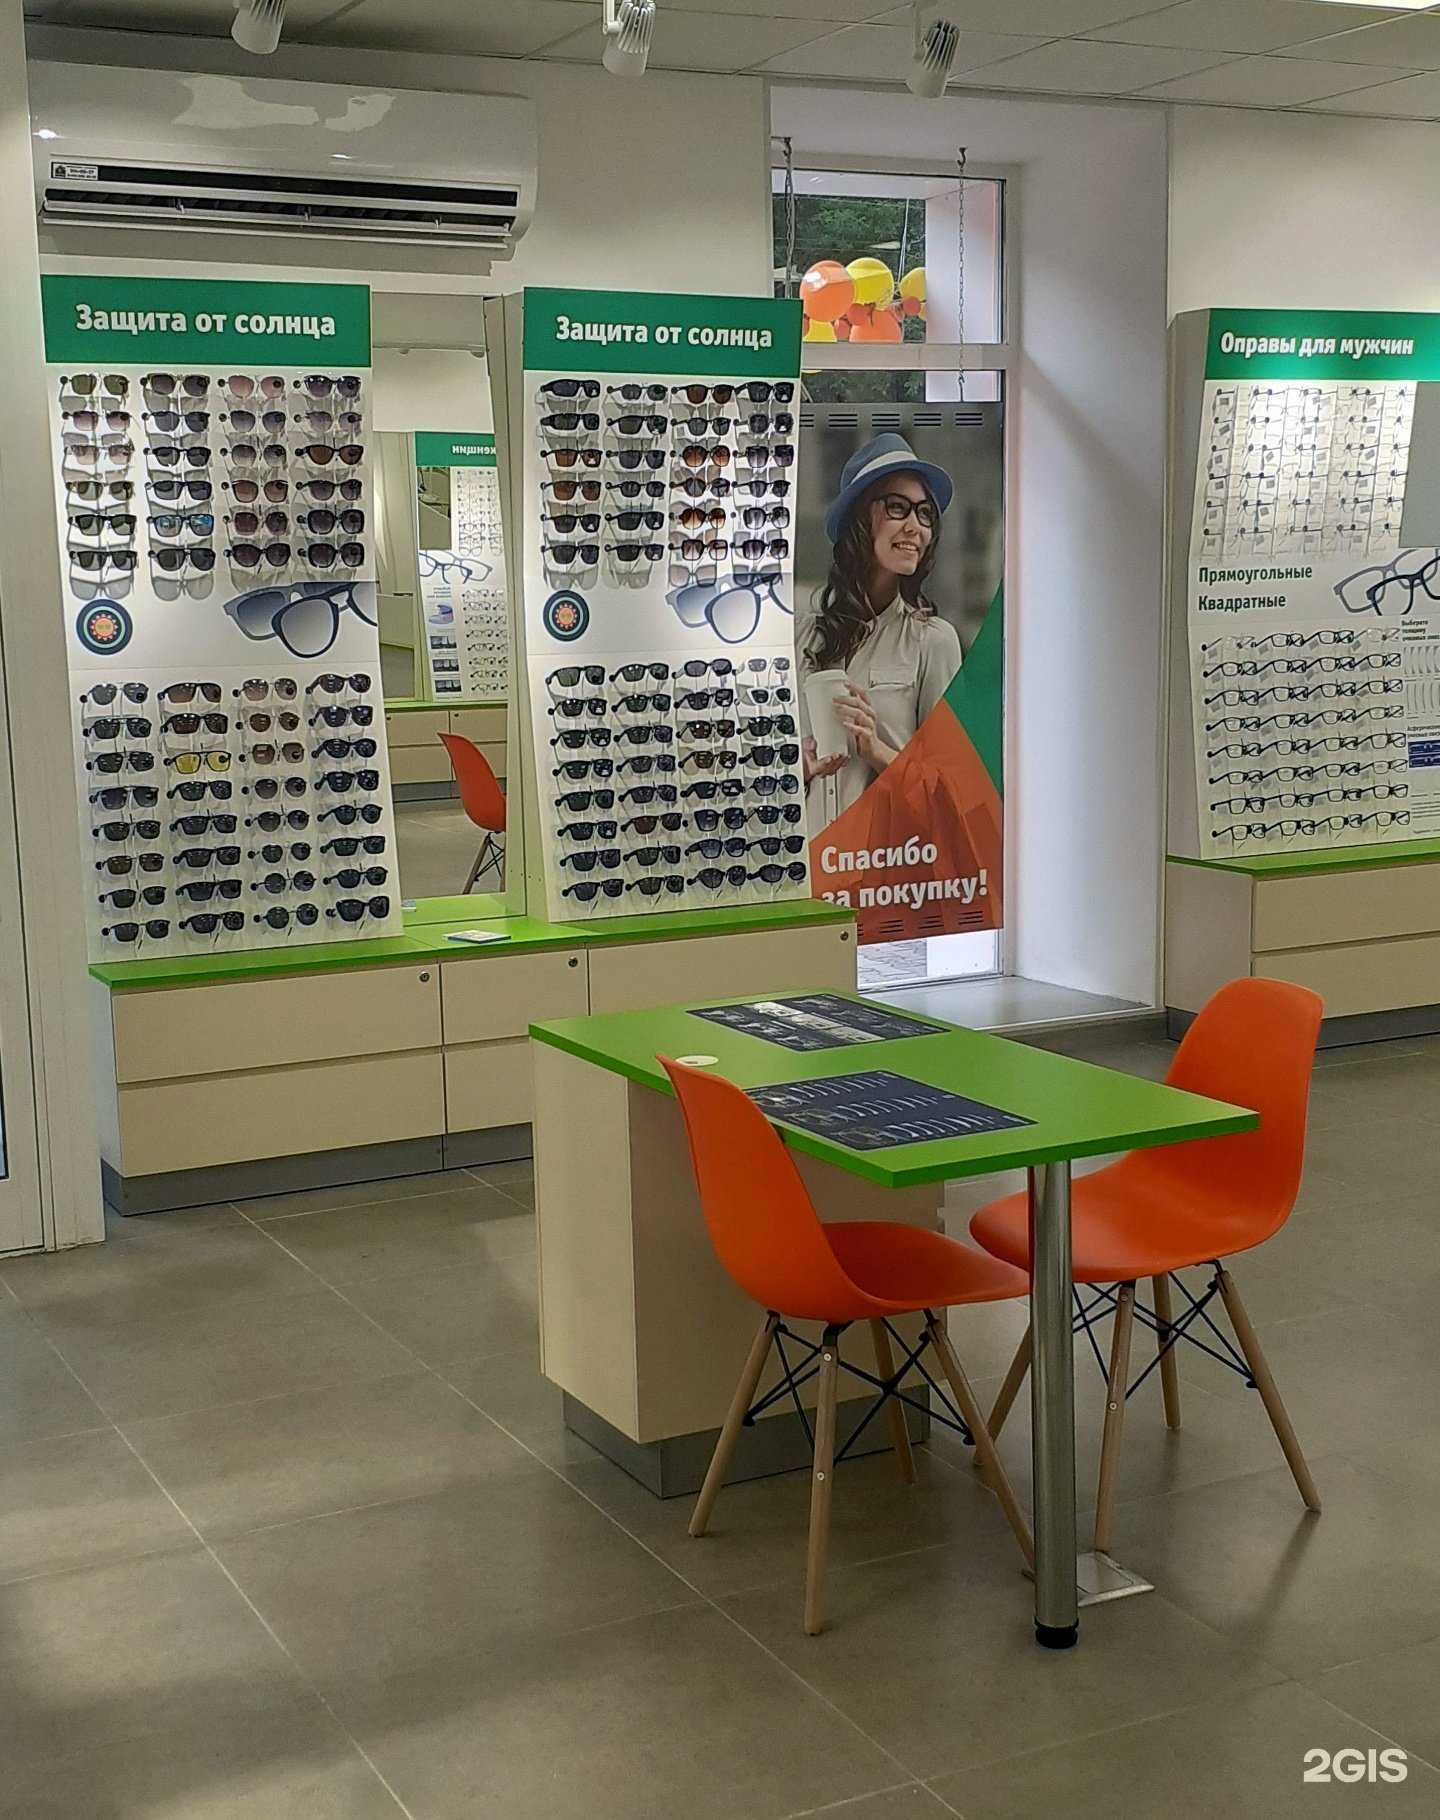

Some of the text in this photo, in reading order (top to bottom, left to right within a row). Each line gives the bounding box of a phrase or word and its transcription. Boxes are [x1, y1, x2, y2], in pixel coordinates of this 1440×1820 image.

[76, 304, 337, 337] Защита от солнца
[555, 316, 772, 349] Защита от солнца
[1220, 331, 1415, 360] Оправы для мужчин
[1199, 566, 1313, 586] Прямоугольные
[1198, 595, 1287, 614] Квадратные
[820, 835, 938, 874] Спасибо
[859, 869, 988, 910] покупку!
